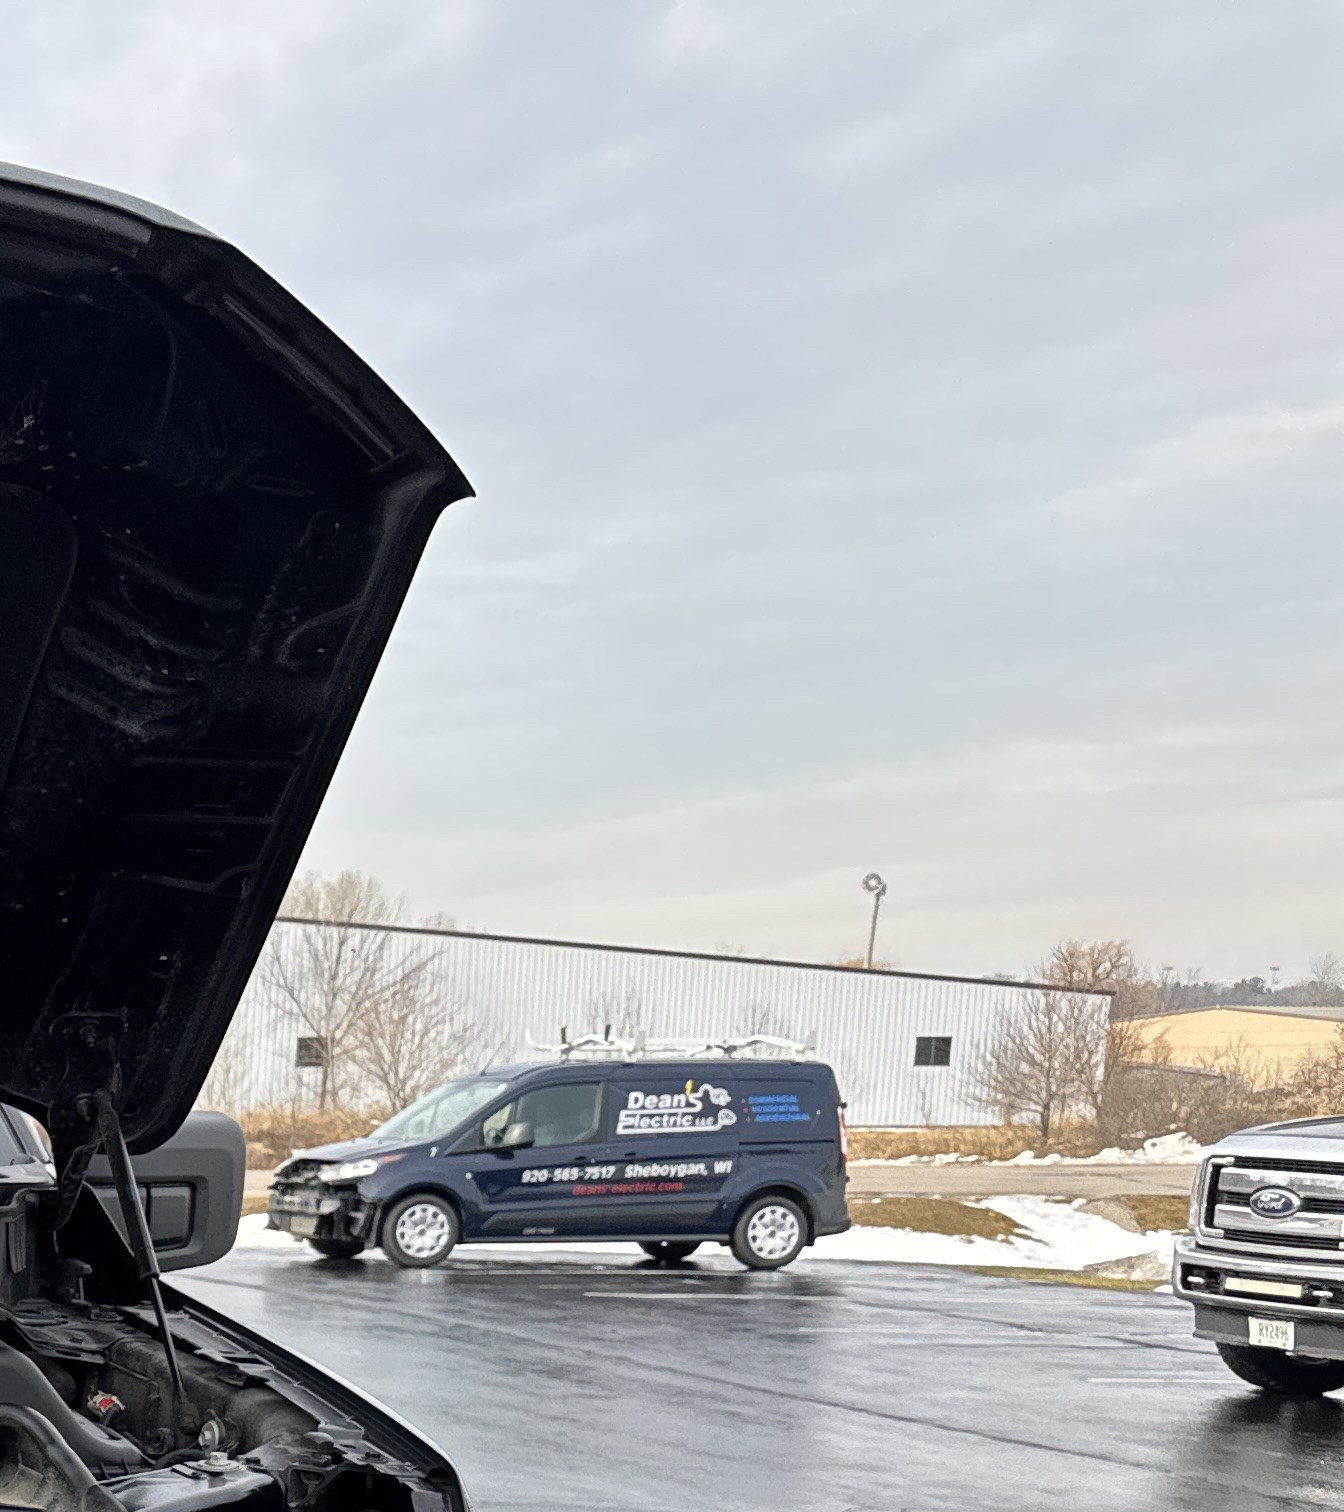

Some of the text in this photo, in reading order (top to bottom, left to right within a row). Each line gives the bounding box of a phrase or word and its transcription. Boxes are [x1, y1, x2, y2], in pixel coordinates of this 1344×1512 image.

[627, 1080, 703, 1110] Dean's
[616, 1110, 693, 1134] Electric
[625, 1162, 707, 1179] Sheboygan,
[713, 1160, 733, 1174] WI
